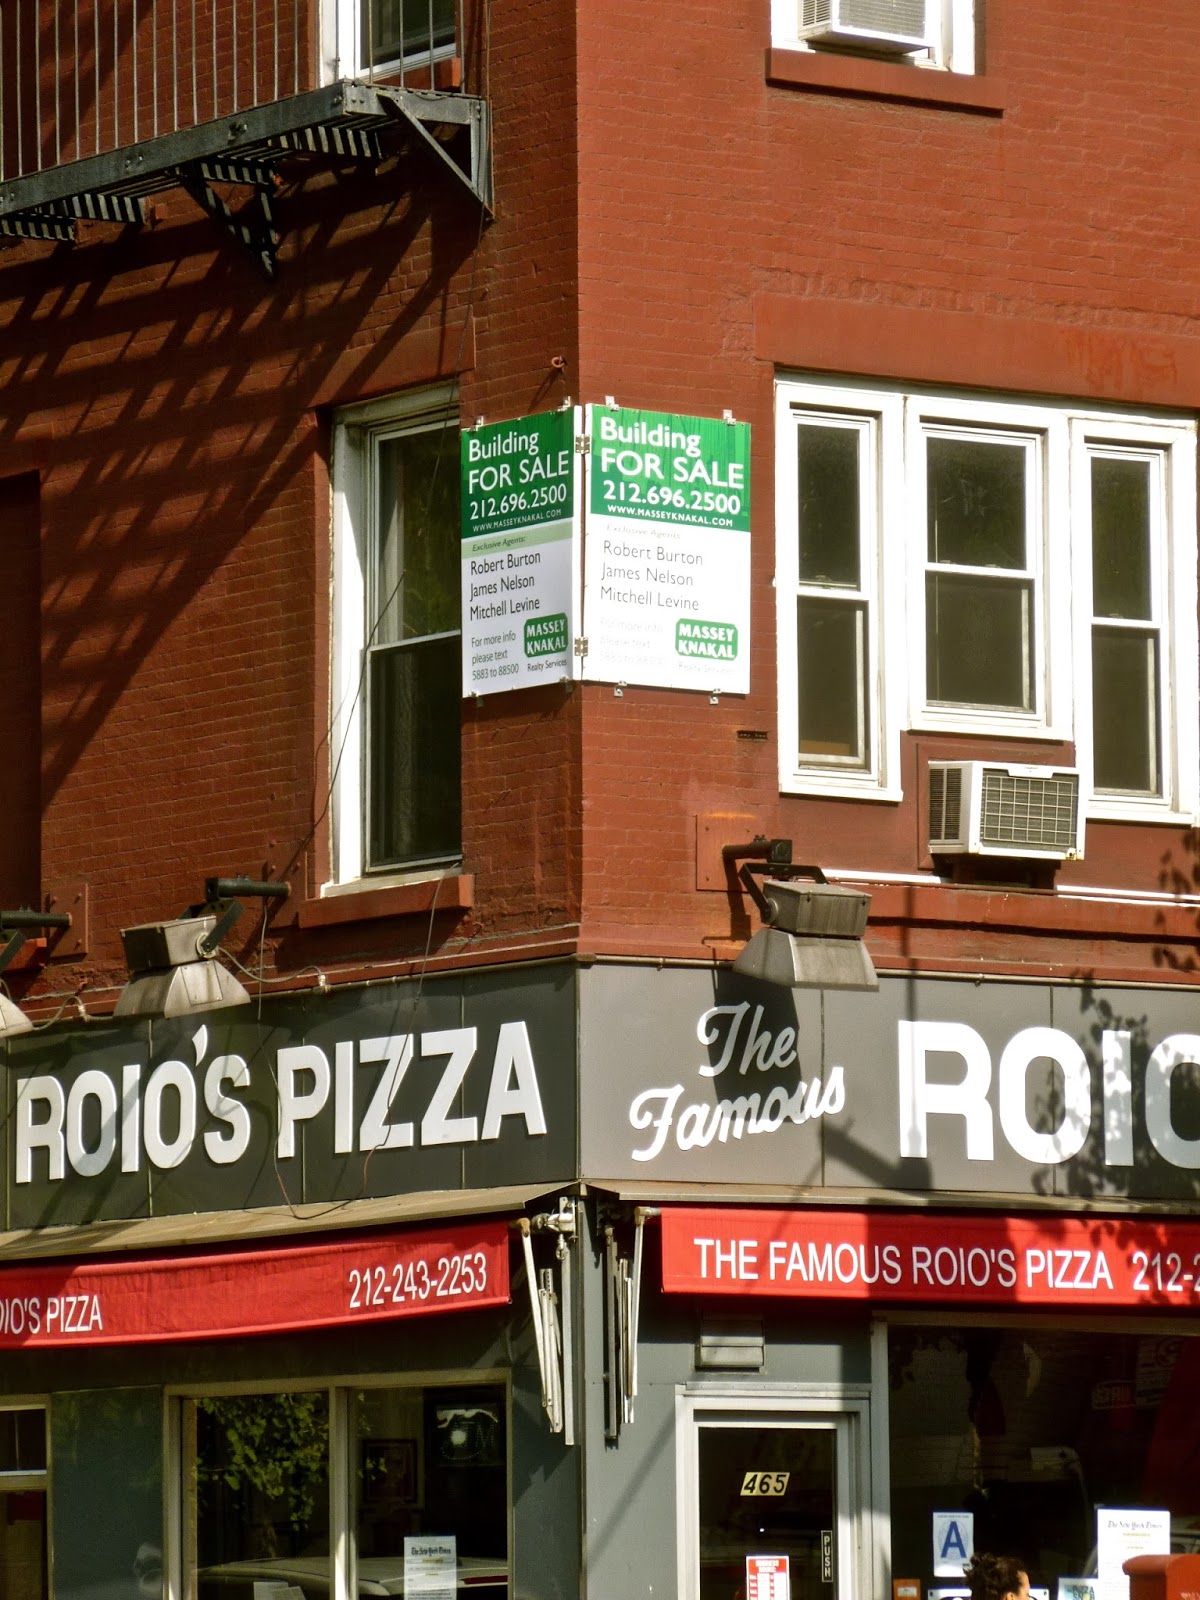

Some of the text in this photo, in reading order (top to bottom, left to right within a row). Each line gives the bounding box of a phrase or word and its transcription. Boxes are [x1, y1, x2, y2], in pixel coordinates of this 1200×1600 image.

[469, 431, 539, 462] Building
[601, 416, 701, 458] Building
[468, 450, 569, 494] FOR SALE
[601, 447, 744, 489] FOR SALE
[470, 483, 567, 520] 212.696.2500
[603, 479, 741, 515] 212.696.2500
[472, 508, 562, 532] WWW.MASSEYKNAKAL.COM
[607, 504, 733, 527] WWW.MASSEYKNAKAL.COM
[472, 540, 501, 552] Exclusive
[603, 540, 703, 565] Robert Burton
[471, 552, 541, 576] Robert Burton
[601, 562, 693, 586] James Nelson
[470, 575, 535, 602] James Nelson
[600, 585, 700, 611] Mitchell Levine
[470, 597, 540, 621] Mitchell Levine
[471, 630, 517, 648] For more info
[526, 618, 565, 638] MASSEY
[679, 623, 734, 642] MASSEY
[526, 636, 567, 654] KNAKAL
[678, 639, 736, 659] KNAKAL
[472, 649, 508, 667] please text
[527, 658, 567, 673] Realty Services
[472, 663, 520, 681] 5883 to 88500
[697, 1001, 797, 1077] The
[15, 1021, 547, 1183] ROIO'S PIZZA
[629, 1066, 845, 1162] Famous
[694, 1238, 759, 1280] THE
[768, 1241, 901, 1285] FAMOUS
[912, 1246, 1016, 1287] ROIO'S
[1027, 1250, 1113, 1289] PIZZA
[349, 1252, 487, 1309] 212-243-2253
[46, 1294, 104, 1333] PIZZA
[744, 1474, 786, 1494] 465
[940, 1521, 967, 1558] A
[823, 1536, 831, 1577] PUSH
